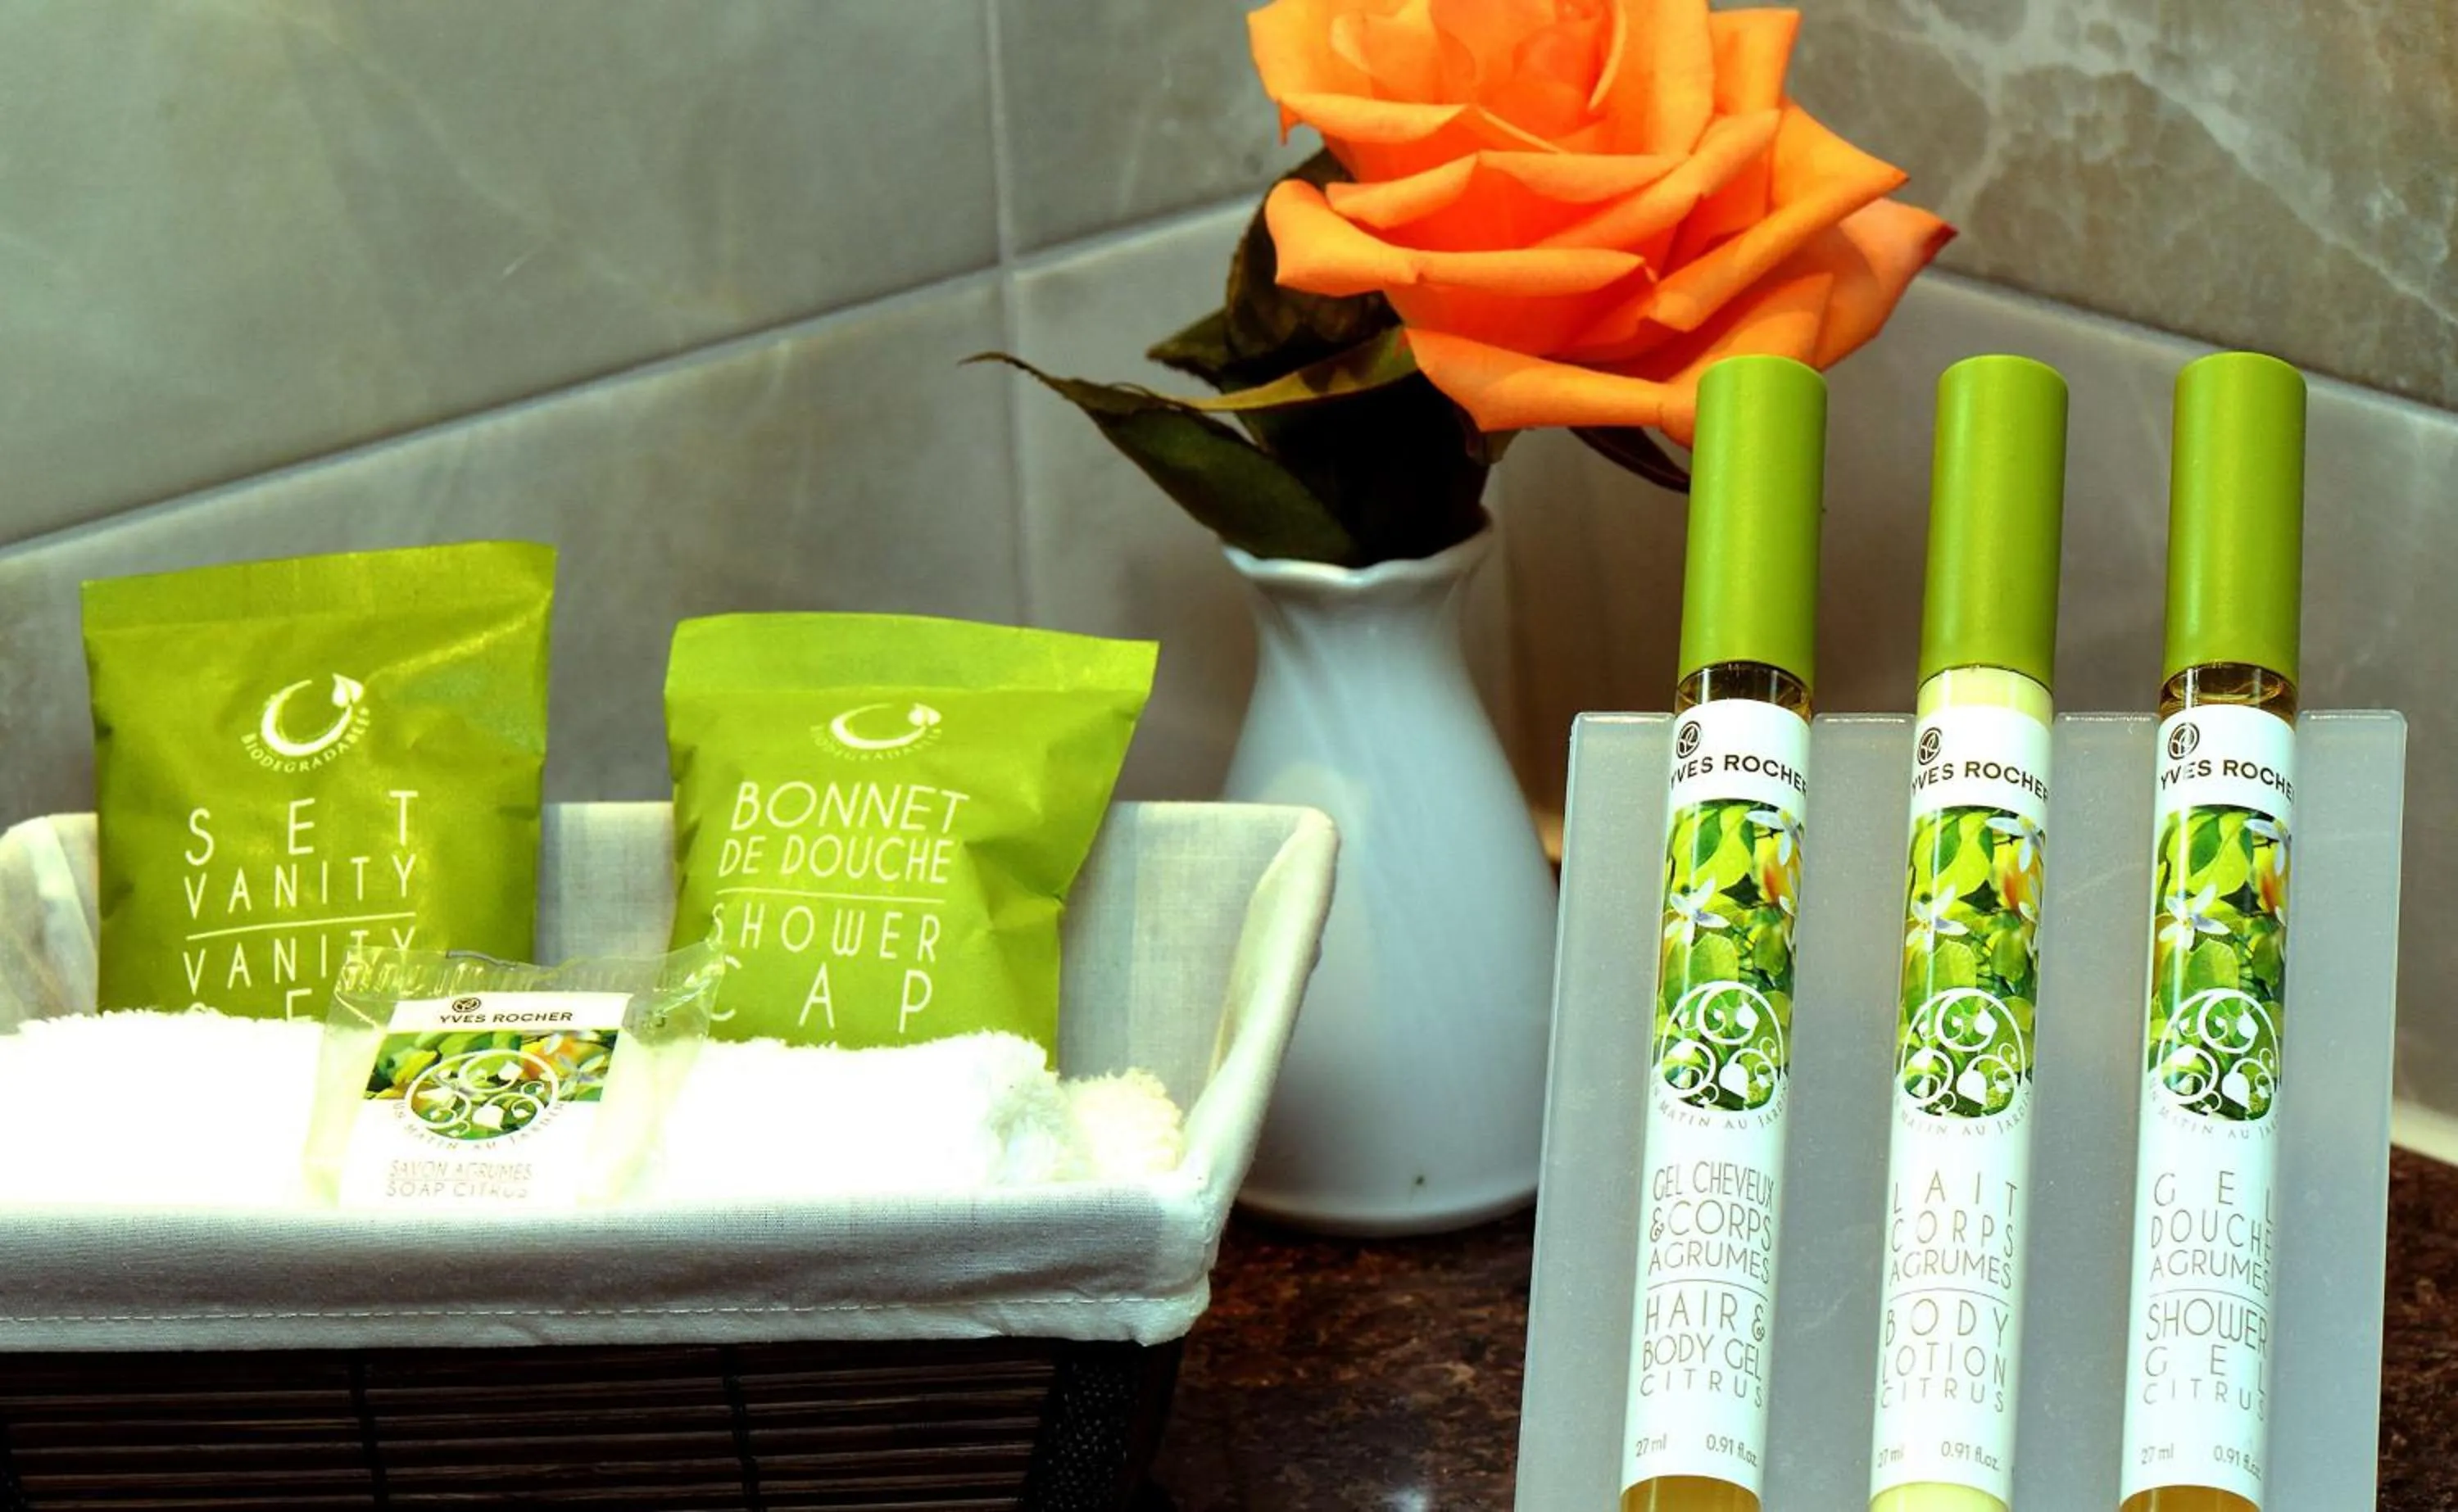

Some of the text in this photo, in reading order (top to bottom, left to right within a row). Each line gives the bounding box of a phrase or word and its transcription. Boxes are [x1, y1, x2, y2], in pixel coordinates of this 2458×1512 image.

[1912, 763, 1954, 796] YVES
[2161, 759, 2294, 804] YVES ROCHE
[185, 790, 418, 866] SET
[731, 781, 969, 834] BONNET
[719, 833, 953, 884] DE DOUCHE
[184, 854, 415, 919] VANITY
[710, 903, 941, 962] SHOWER
[184, 926, 415, 996] VANITY
[440, 1011, 573, 1024] YVES ROCHER
[1659, 1101, 1711, 1128] MATIN
[1724, 1120, 1748, 1129] AU
[1962, 1125, 1985, 1135] AU
[2228, 1129, 2249, 1139] AU
[385, 1180, 445, 1197] SOAP
[389, 1160, 448, 1179] SAVON
[1653, 1161, 1774, 1211] GEL CHEVEUX
[1893, 1170, 2018, 1217] LAIT
[2154, 1170, 2273, 1225] GEL
[1892, 1209, 2013, 1258] CORPS
[2151, 1208, 2272, 1265] DOUCHE
[1648, 1240, 1769, 1284] AGRUMES
[1889, 1248, 2012, 1290] AGRUMES
[2149, 1249, 2269, 1297] AGRUMES
[1645, 1289, 1737, 1334] HAIR
[1885, 1298, 2008, 1348] BODY
[2146, 1298, 2267, 1359] SHOWER
[1644, 1333, 1762, 1382] BODY GEL
[1882, 1342, 2007, 1388] LOTION
[2145, 1344, 2265, 1396] GEL
[1640, 1369, 1762, 1408] CITRUS
[1881, 1377, 2003, 1413] CITRUS
[2143, 1378, 2264, 1421] CITRUS
[1635, 1438, 1649, 1457] 27
[1651, 1433, 1667, 1452] ml
[1706, 1434, 1734, 1455] 0.91
[1941, 1441, 1970, 1461] 0.91
[2141, 1446, 2156, 1465] 27
[2158, 1442, 2174, 1461] ml
[2213, 1445, 2239, 1467] 0.91
